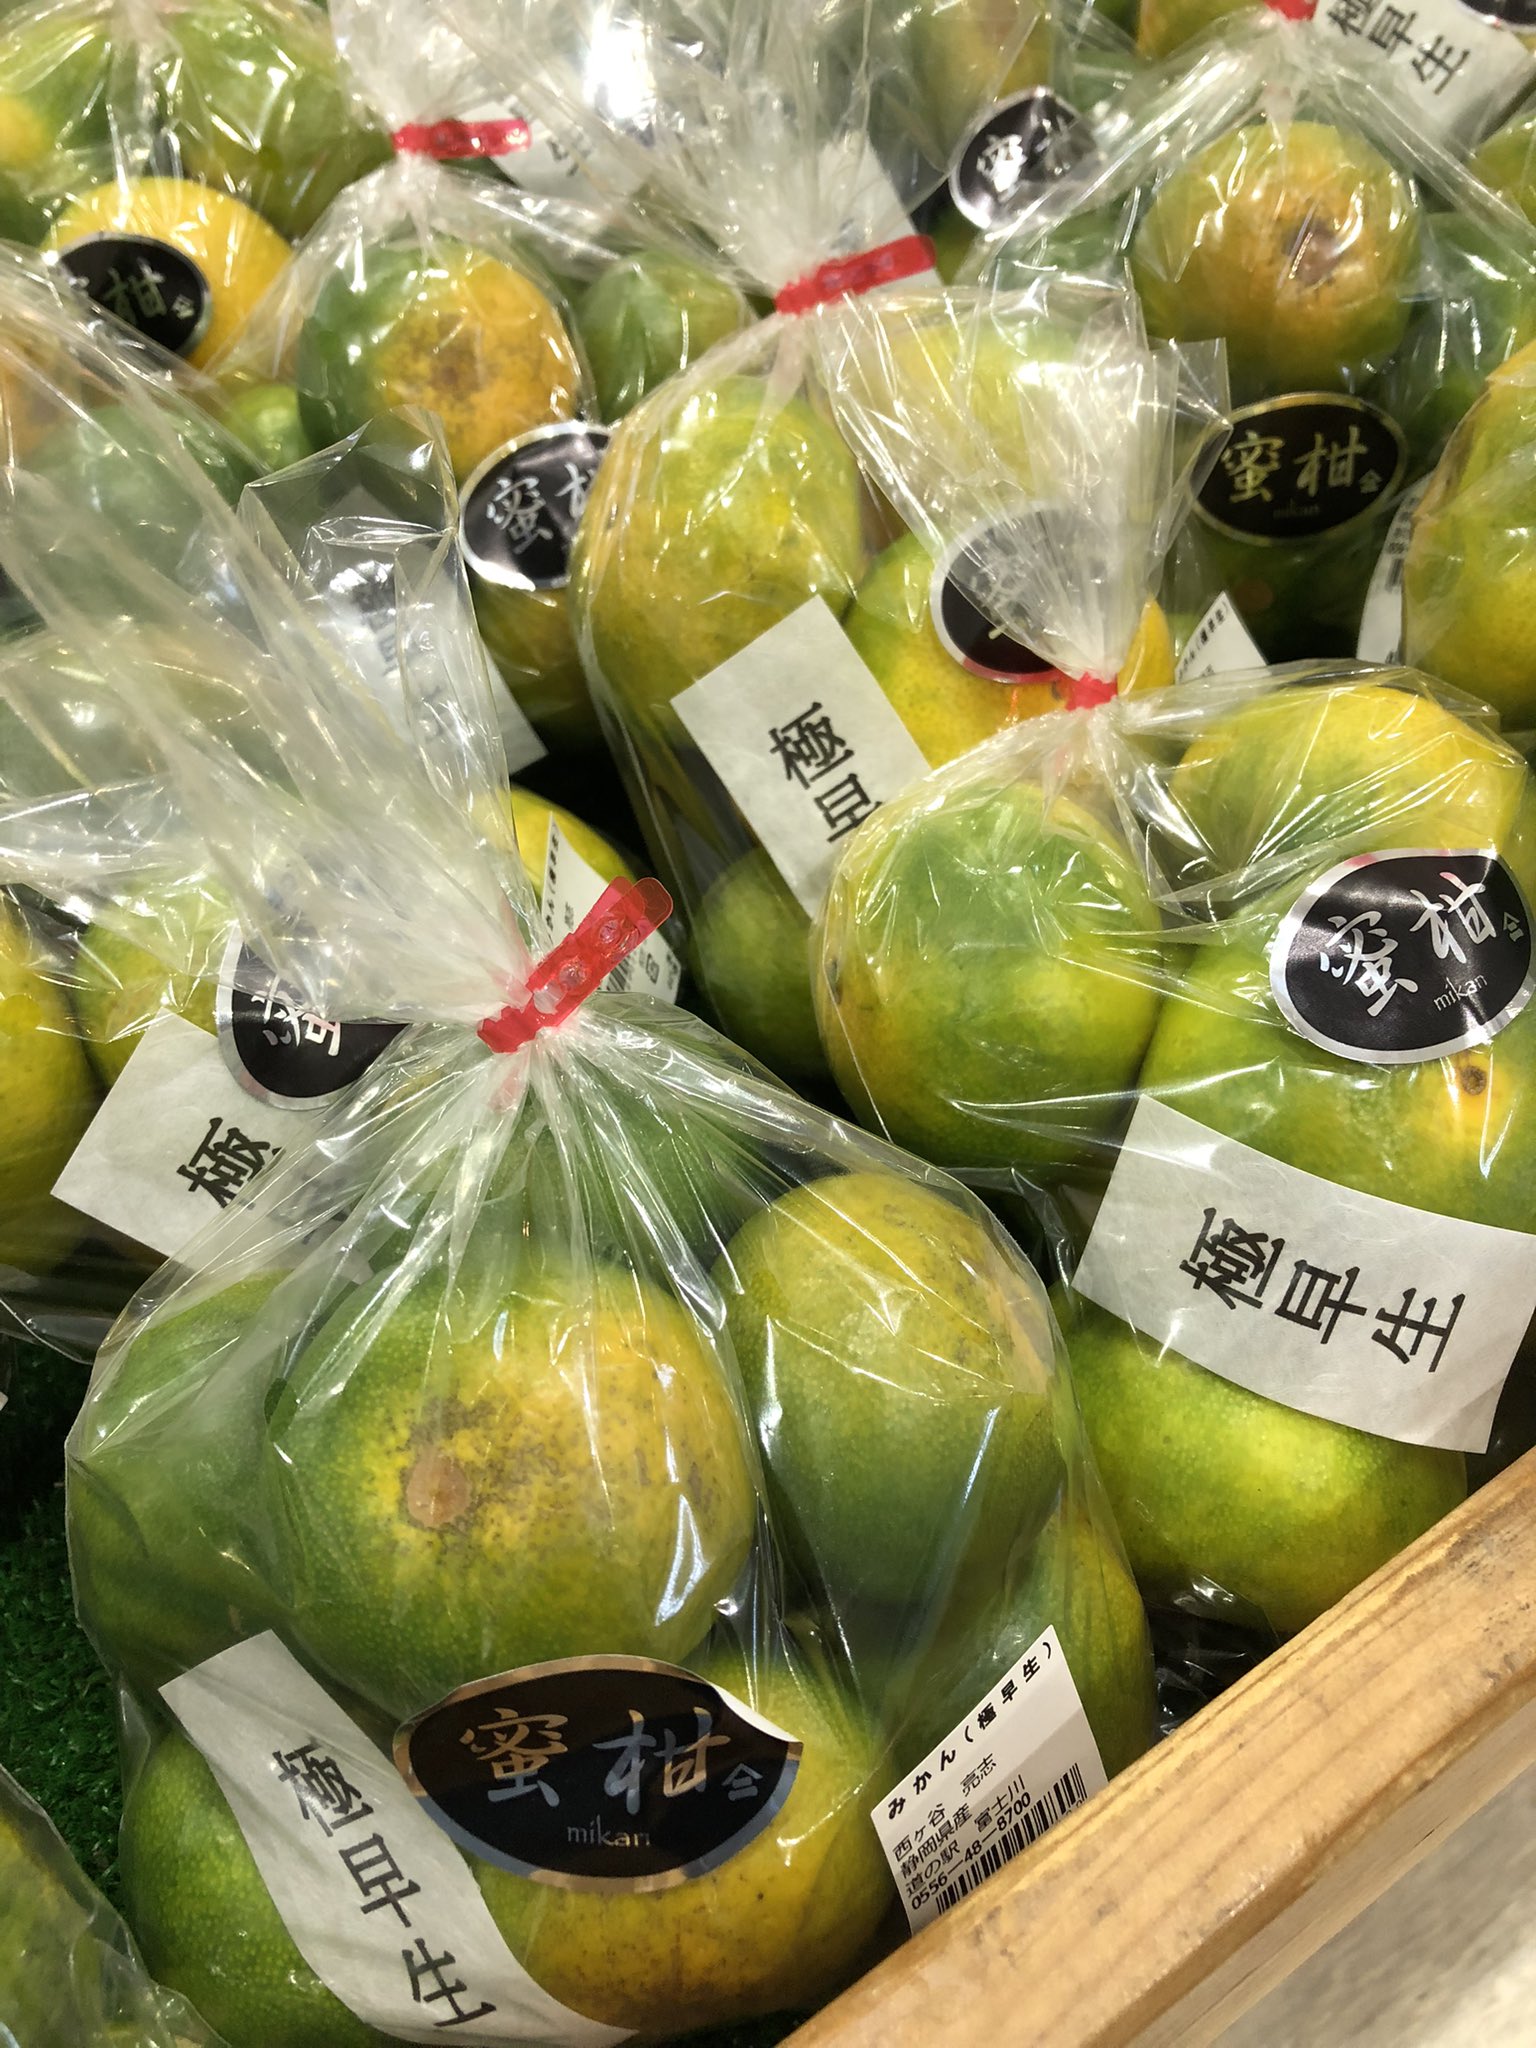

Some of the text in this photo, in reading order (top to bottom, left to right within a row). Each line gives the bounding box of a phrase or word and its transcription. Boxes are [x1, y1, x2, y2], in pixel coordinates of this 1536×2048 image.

[1221, 424, 1368, 503] 蜜柑
[1319, 871, 1497, 1016] 蜜柑
[1433, 974, 1488, 1012] mikan
[1179, 1208, 1465, 1372] 極早生
[459, 1706, 731, 1815] 蜜柑
[960, 1753, 997, 1797] 亮志
[567, 1814, 651, 1849] mikan
[900, 1803, 973, 1879] 静岡県産
[906, 1775, 1026, 1898] 道の駅 富士川
[271, 1741, 496, 2027] 極早生
